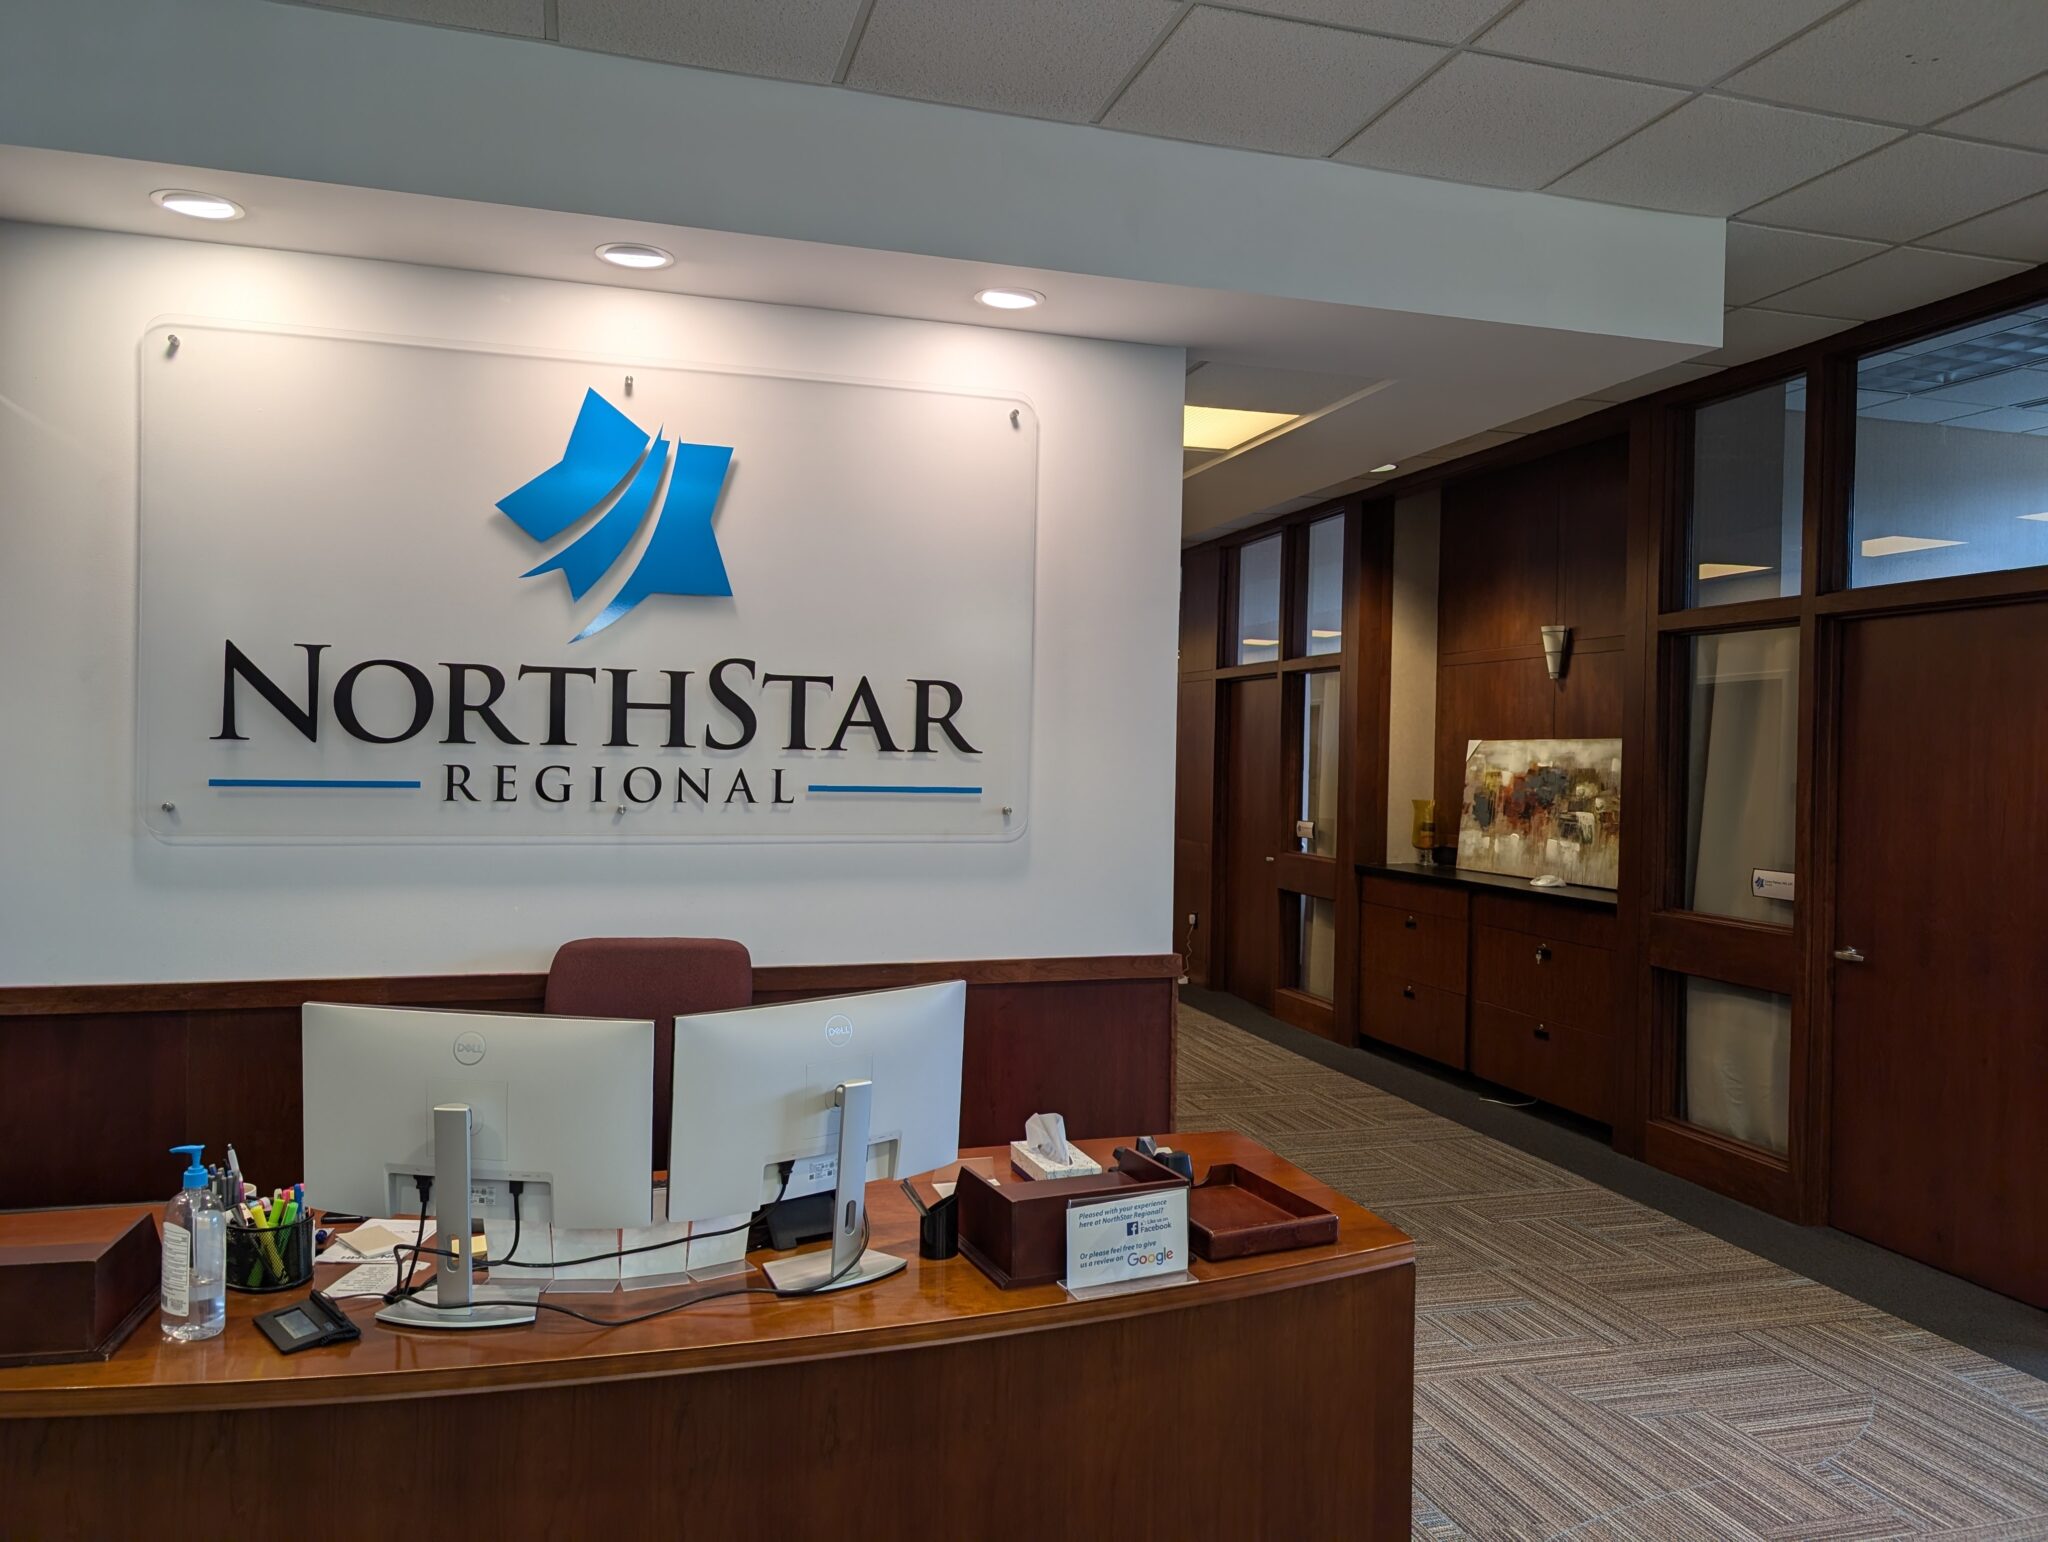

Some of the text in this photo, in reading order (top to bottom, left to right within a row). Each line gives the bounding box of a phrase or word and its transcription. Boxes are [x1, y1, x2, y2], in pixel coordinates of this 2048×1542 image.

[442, 763, 796, 804] REGIONAL
[828, 1025, 851, 1037] DELL
[456, 1042, 483, 1054] DELL
[1079, 1210, 1103, 1220] Pleased
[1119, 1206, 1133, 1214] your
[1134, 1200, 1167, 1210] experience
[1103, 1214, 1132, 1224] NorthStar
[1134, 1208, 1164, 1218] Regional?
[1141, 1222, 1171, 1233] Facebook
[1089, 1249, 1109, 1259] please
[1094, 1257, 1115, 1265] review
[1128, 1247, 1173, 1266] Google
